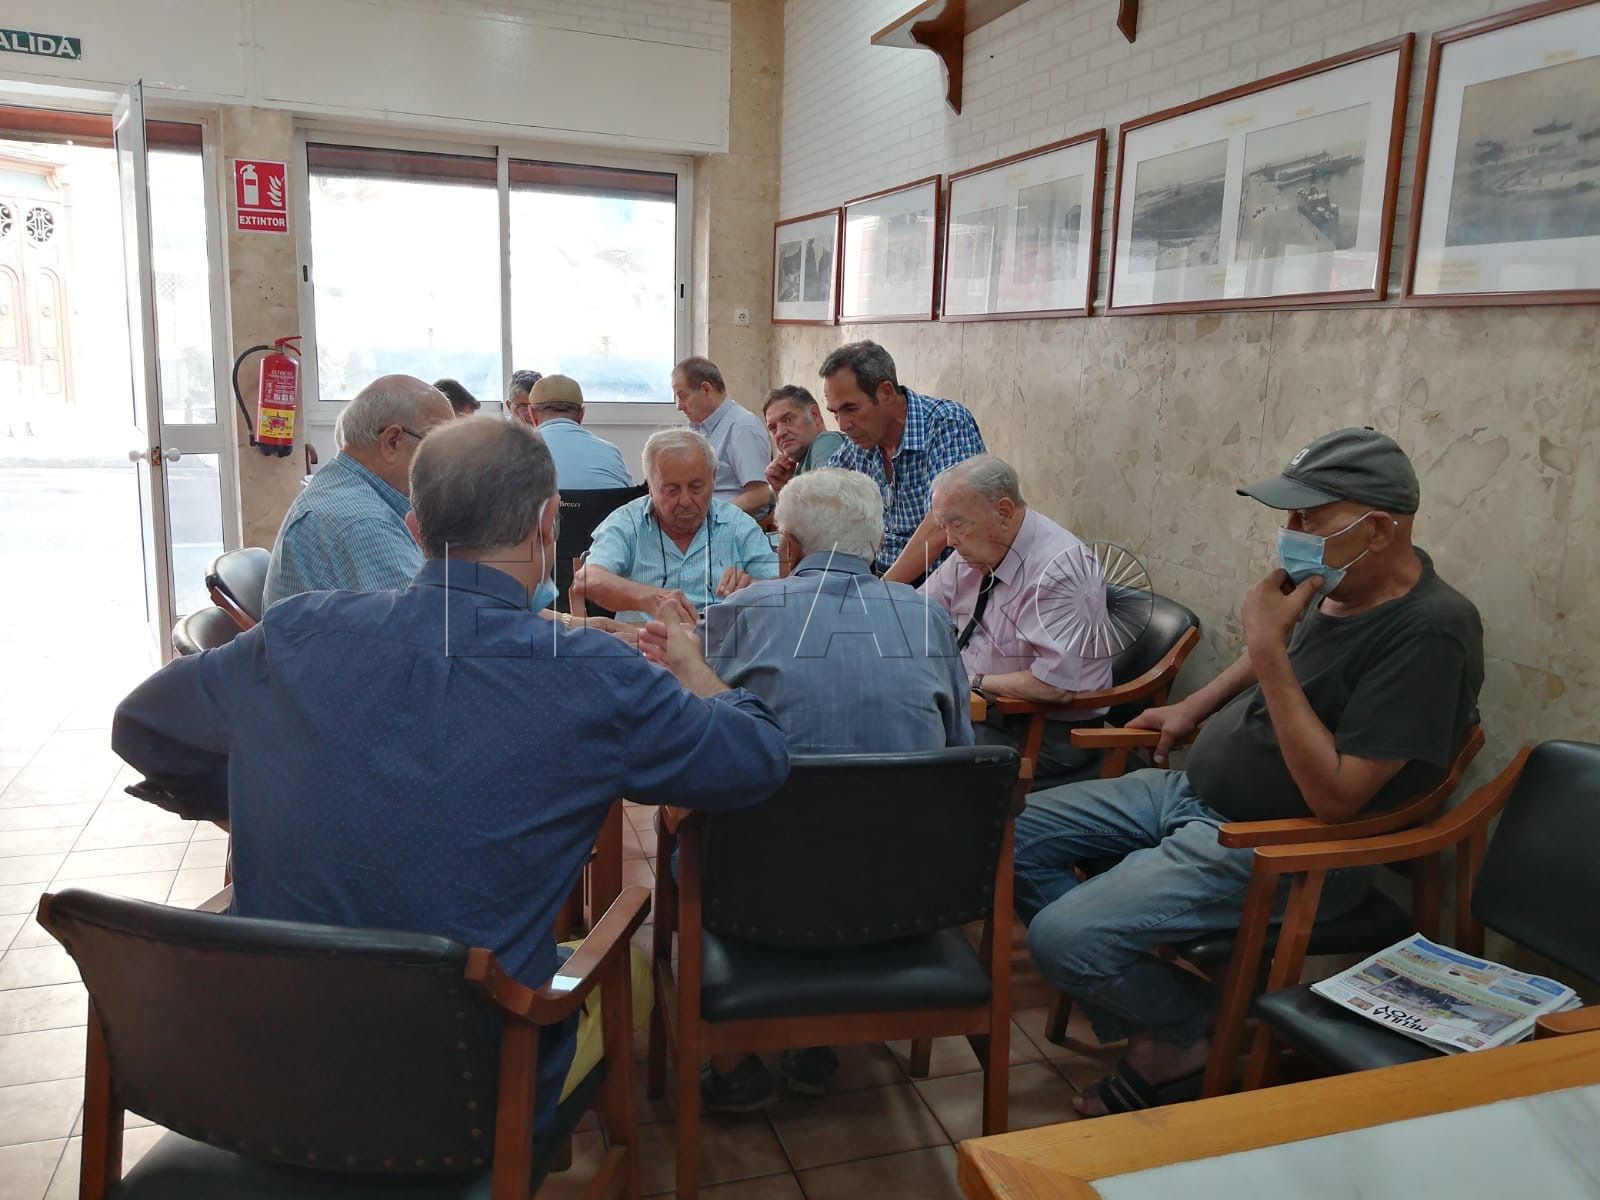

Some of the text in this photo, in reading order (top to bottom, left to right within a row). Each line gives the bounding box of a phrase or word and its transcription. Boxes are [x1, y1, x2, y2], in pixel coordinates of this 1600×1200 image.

[239, 215, 286, 227] EXTINTOR
[1372, 1008, 1428, 1032] MELILLA
[1378, 1005, 1422, 1023] HOY
